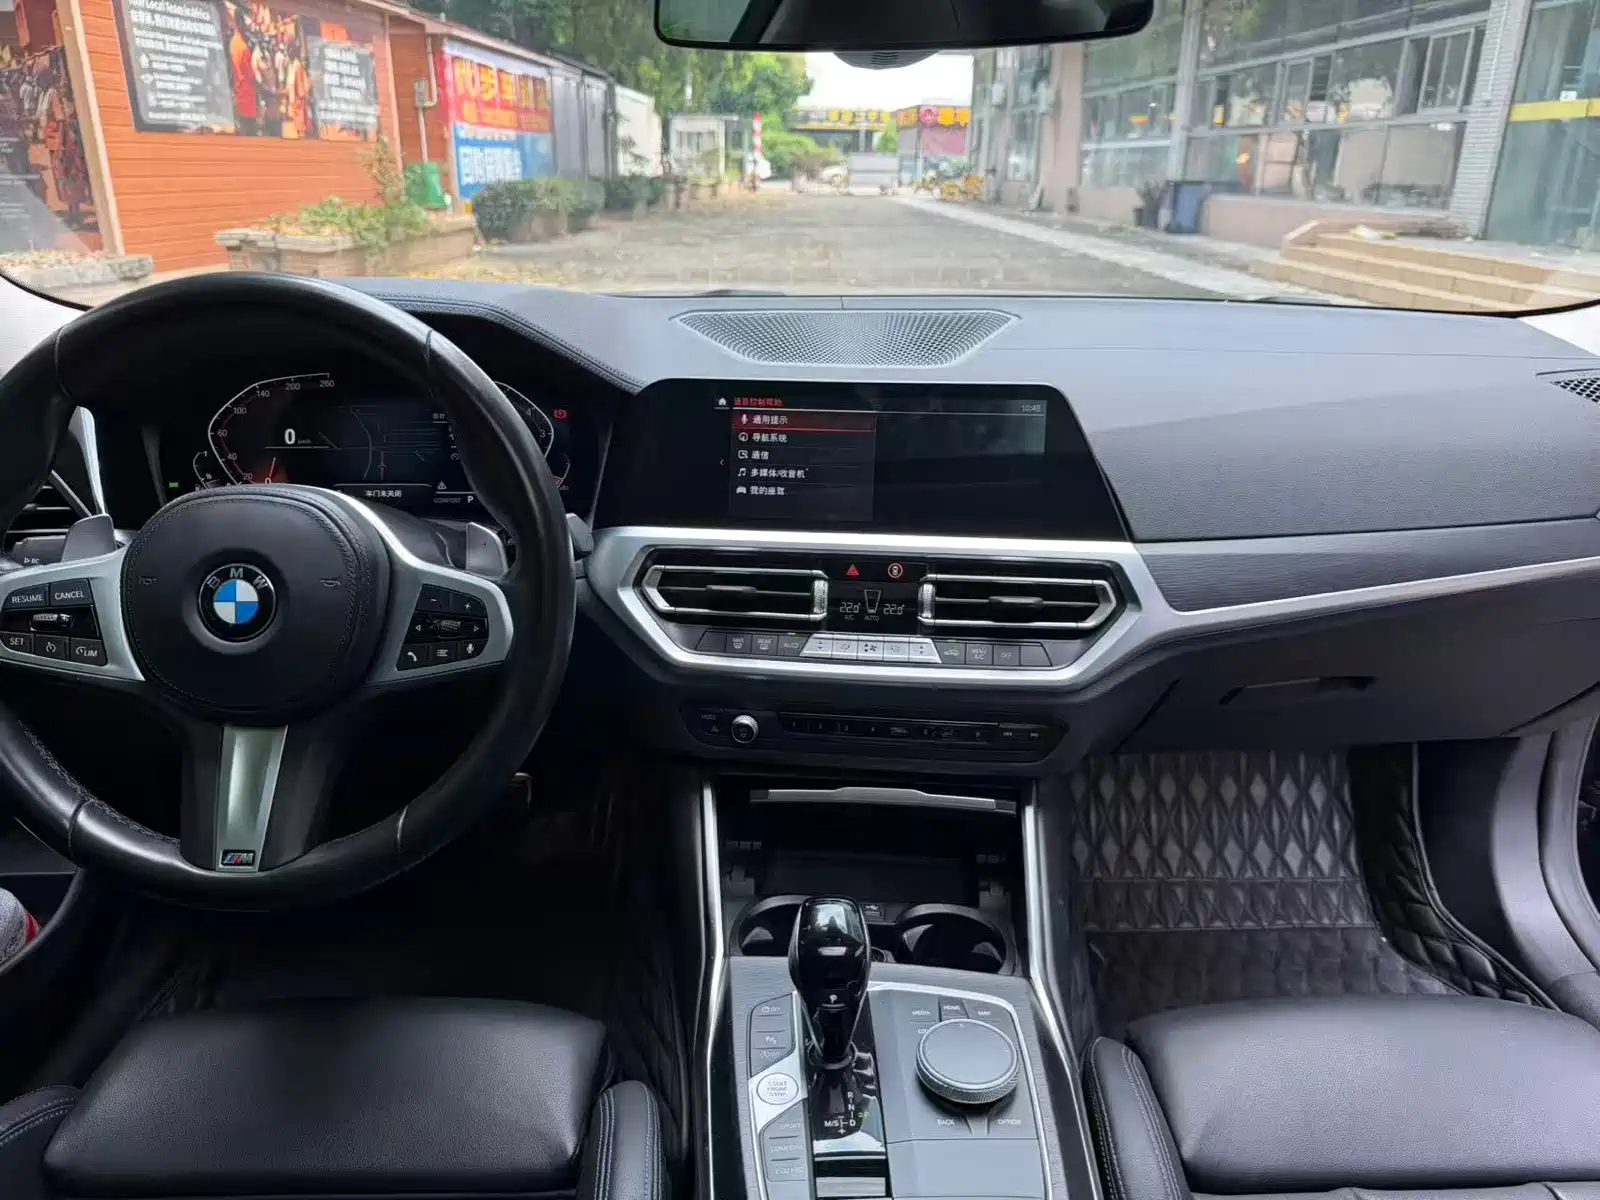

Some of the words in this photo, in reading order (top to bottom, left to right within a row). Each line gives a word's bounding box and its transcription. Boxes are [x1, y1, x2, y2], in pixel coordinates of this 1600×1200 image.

[285, 382, 301, 391] 200
[256, 389, 270, 398] 140
[233, 407, 247, 415] 100
[752, 414, 788, 425] 通用提示
[217, 429, 228, 437] 60
[284, 428, 296, 445] 0
[540, 429, 546, 438] 3
[752, 432, 787, 443] 导航系统
[227, 452, 238, 461] 40
[751, 450, 769, 460] 通信
[243, 472, 253, 480] 20
[750, 468, 806, 479] 多媒体/收音机
[467, 495, 474, 504] P
[206, 567, 269, 590] BMW
[12, 593, 44, 603] RESUME
[54, 590, 85, 600] CANCEL
[9, 637, 25, 646] SET
[84, 649, 98, 657] LIM
[847, 1091, 854, 1099] R
[848, 1103, 855, 1111] N
